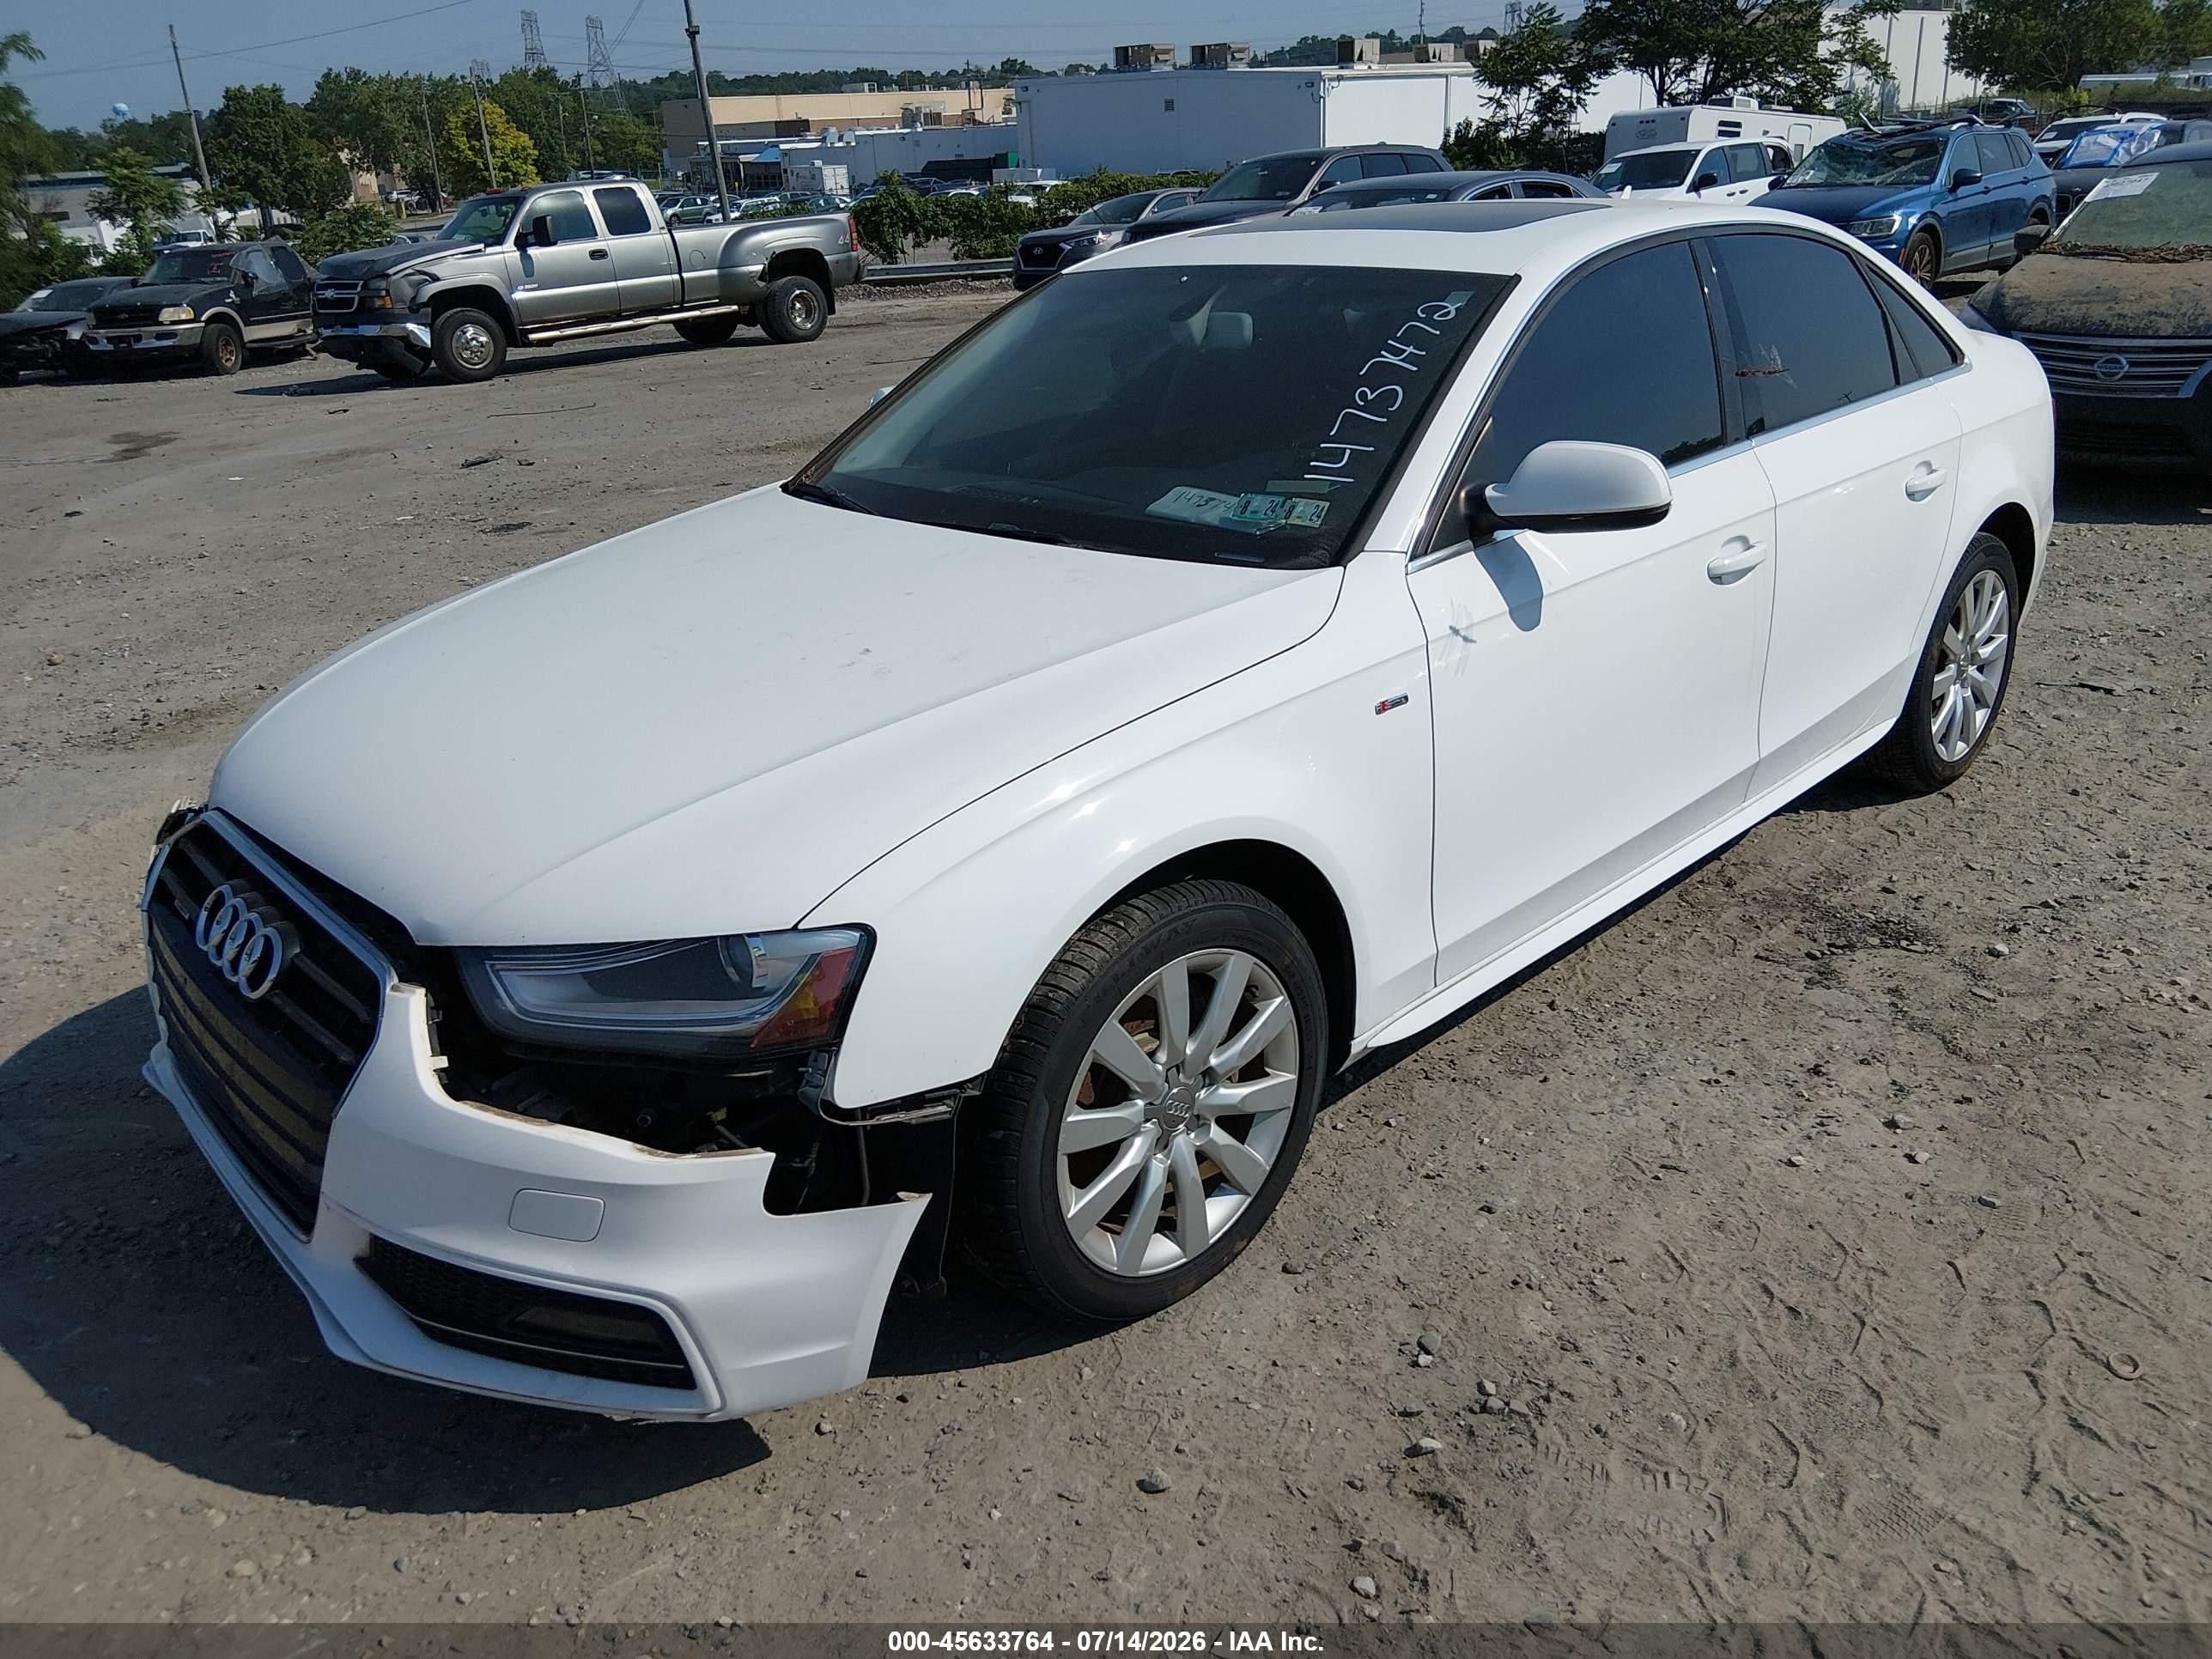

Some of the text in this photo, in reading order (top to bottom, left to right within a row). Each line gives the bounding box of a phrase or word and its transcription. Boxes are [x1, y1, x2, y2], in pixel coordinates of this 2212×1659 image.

[1304, 301, 1463, 483] 14737472
[1264, 499, 1280, 517] 24
[1309, 504, 1326, 523] 24
